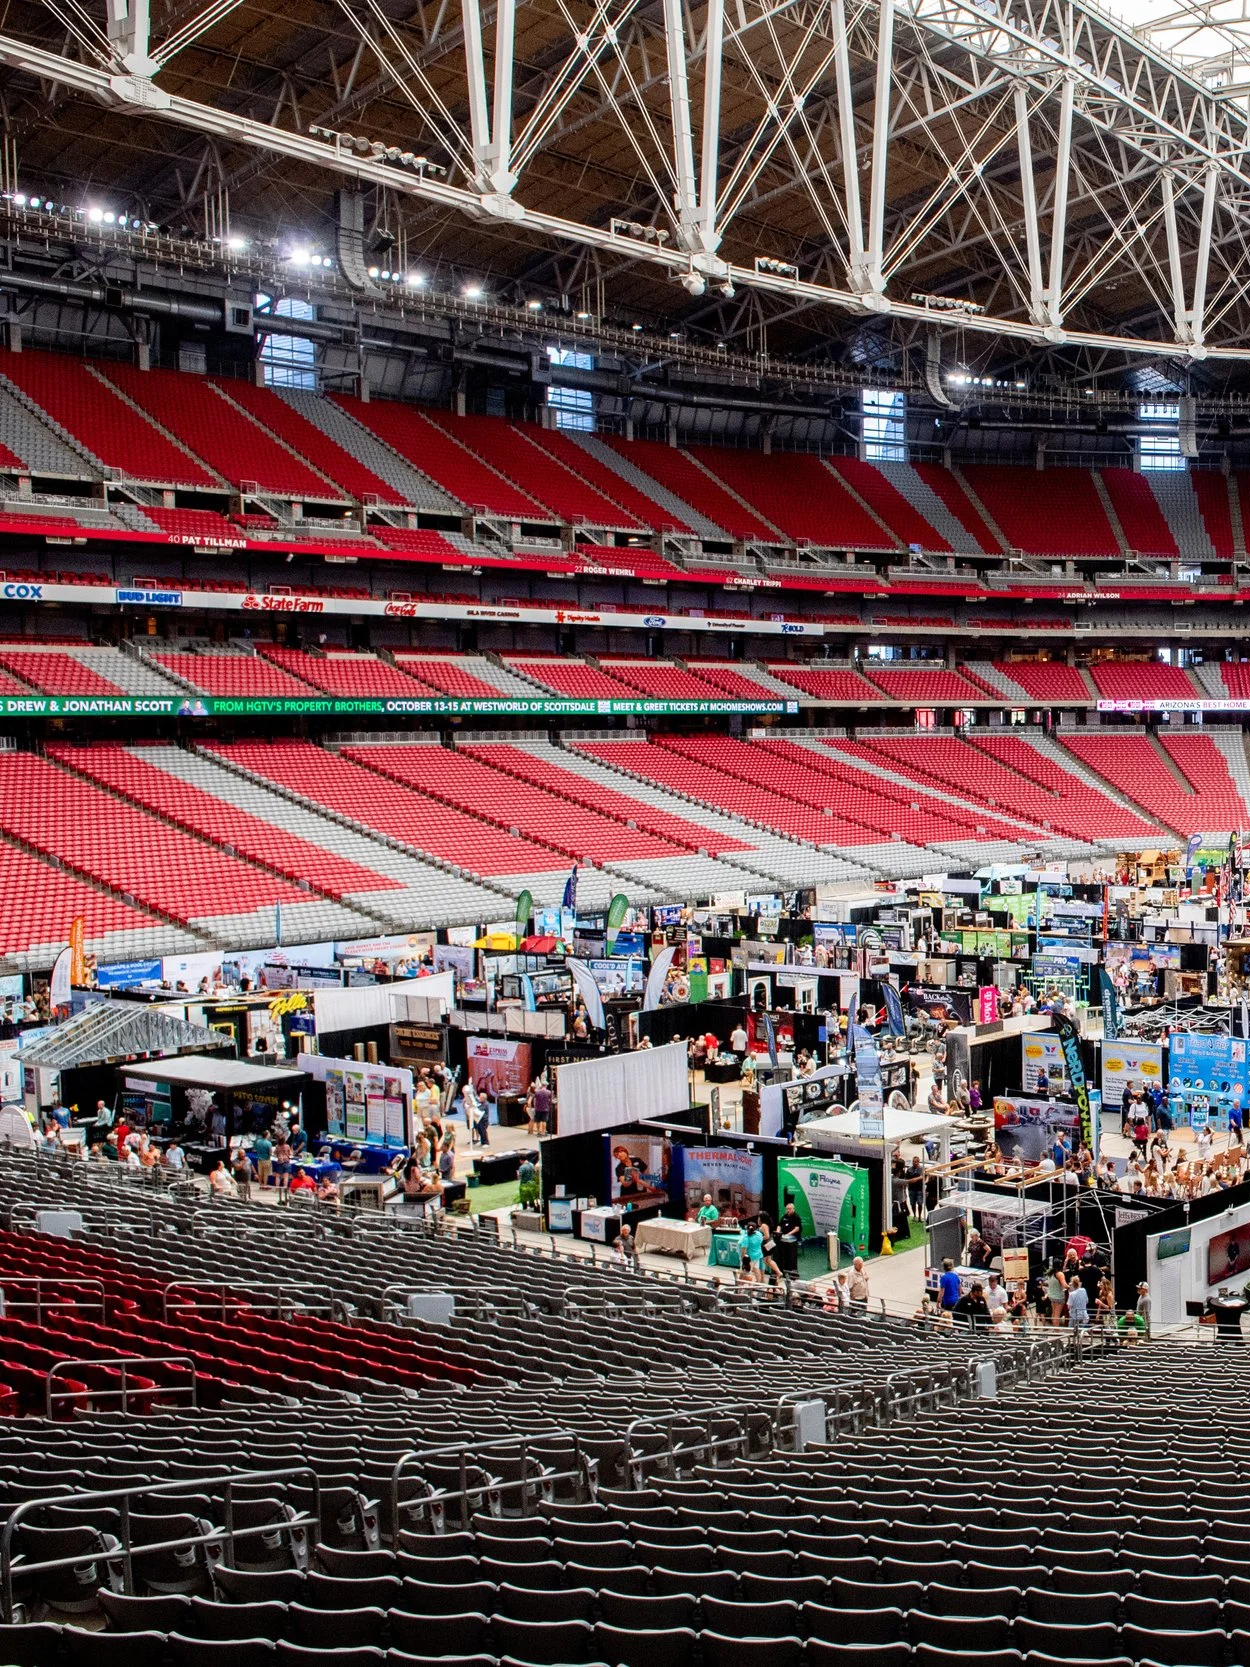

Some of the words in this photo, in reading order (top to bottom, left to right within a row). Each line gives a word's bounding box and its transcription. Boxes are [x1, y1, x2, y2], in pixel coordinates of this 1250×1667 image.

[168, 535, 180, 544] 40
[181, 536, 201, 546] PAT
[203, 537, 247, 548] TILLMAN
[584, 566, 608, 575] ROGER
[609, 567, 635, 576] WEHRLI
[734, 577, 758, 586] CHARLEY
[759, 579, 782, 587] TRIPPI
[4, 584, 43, 599] COX
[119, 591, 144, 602] BUD
[146, 592, 181, 603] LIGHT
[8, 701, 47, 712] DREW
[49, 701, 60, 712] &
[62, 701, 132, 712] JONATHAN
[135, 701, 173, 712] SCOTT
[213, 701, 244, 711] FROM
[246, 701, 282, 711] HGTV'S
[284, 701, 332, 711] PROPERTY
[335, 701, 385, 712] BROTHERS,
[386, 701, 432, 711] OCTOBER
[434, 701, 459, 711] 13-15
[460, 701, 471, 711] AT
[473, 701, 529, 711] WESTWORLD
[530, 701, 543, 711] OF
[543, 701, 596, 711] SCOTTSDALE
[613, 702, 634, 711] MEET
[636, 702, 642, 711] &
[643, 702, 668, 711] GREET
[669, 702, 698, 711] TICKETS
[699, 702, 708, 711] AT
[710, 702, 784, 711] MCHOMESHOWS.COM
[1159, 701, 1201, 709] ARIZONA'S
